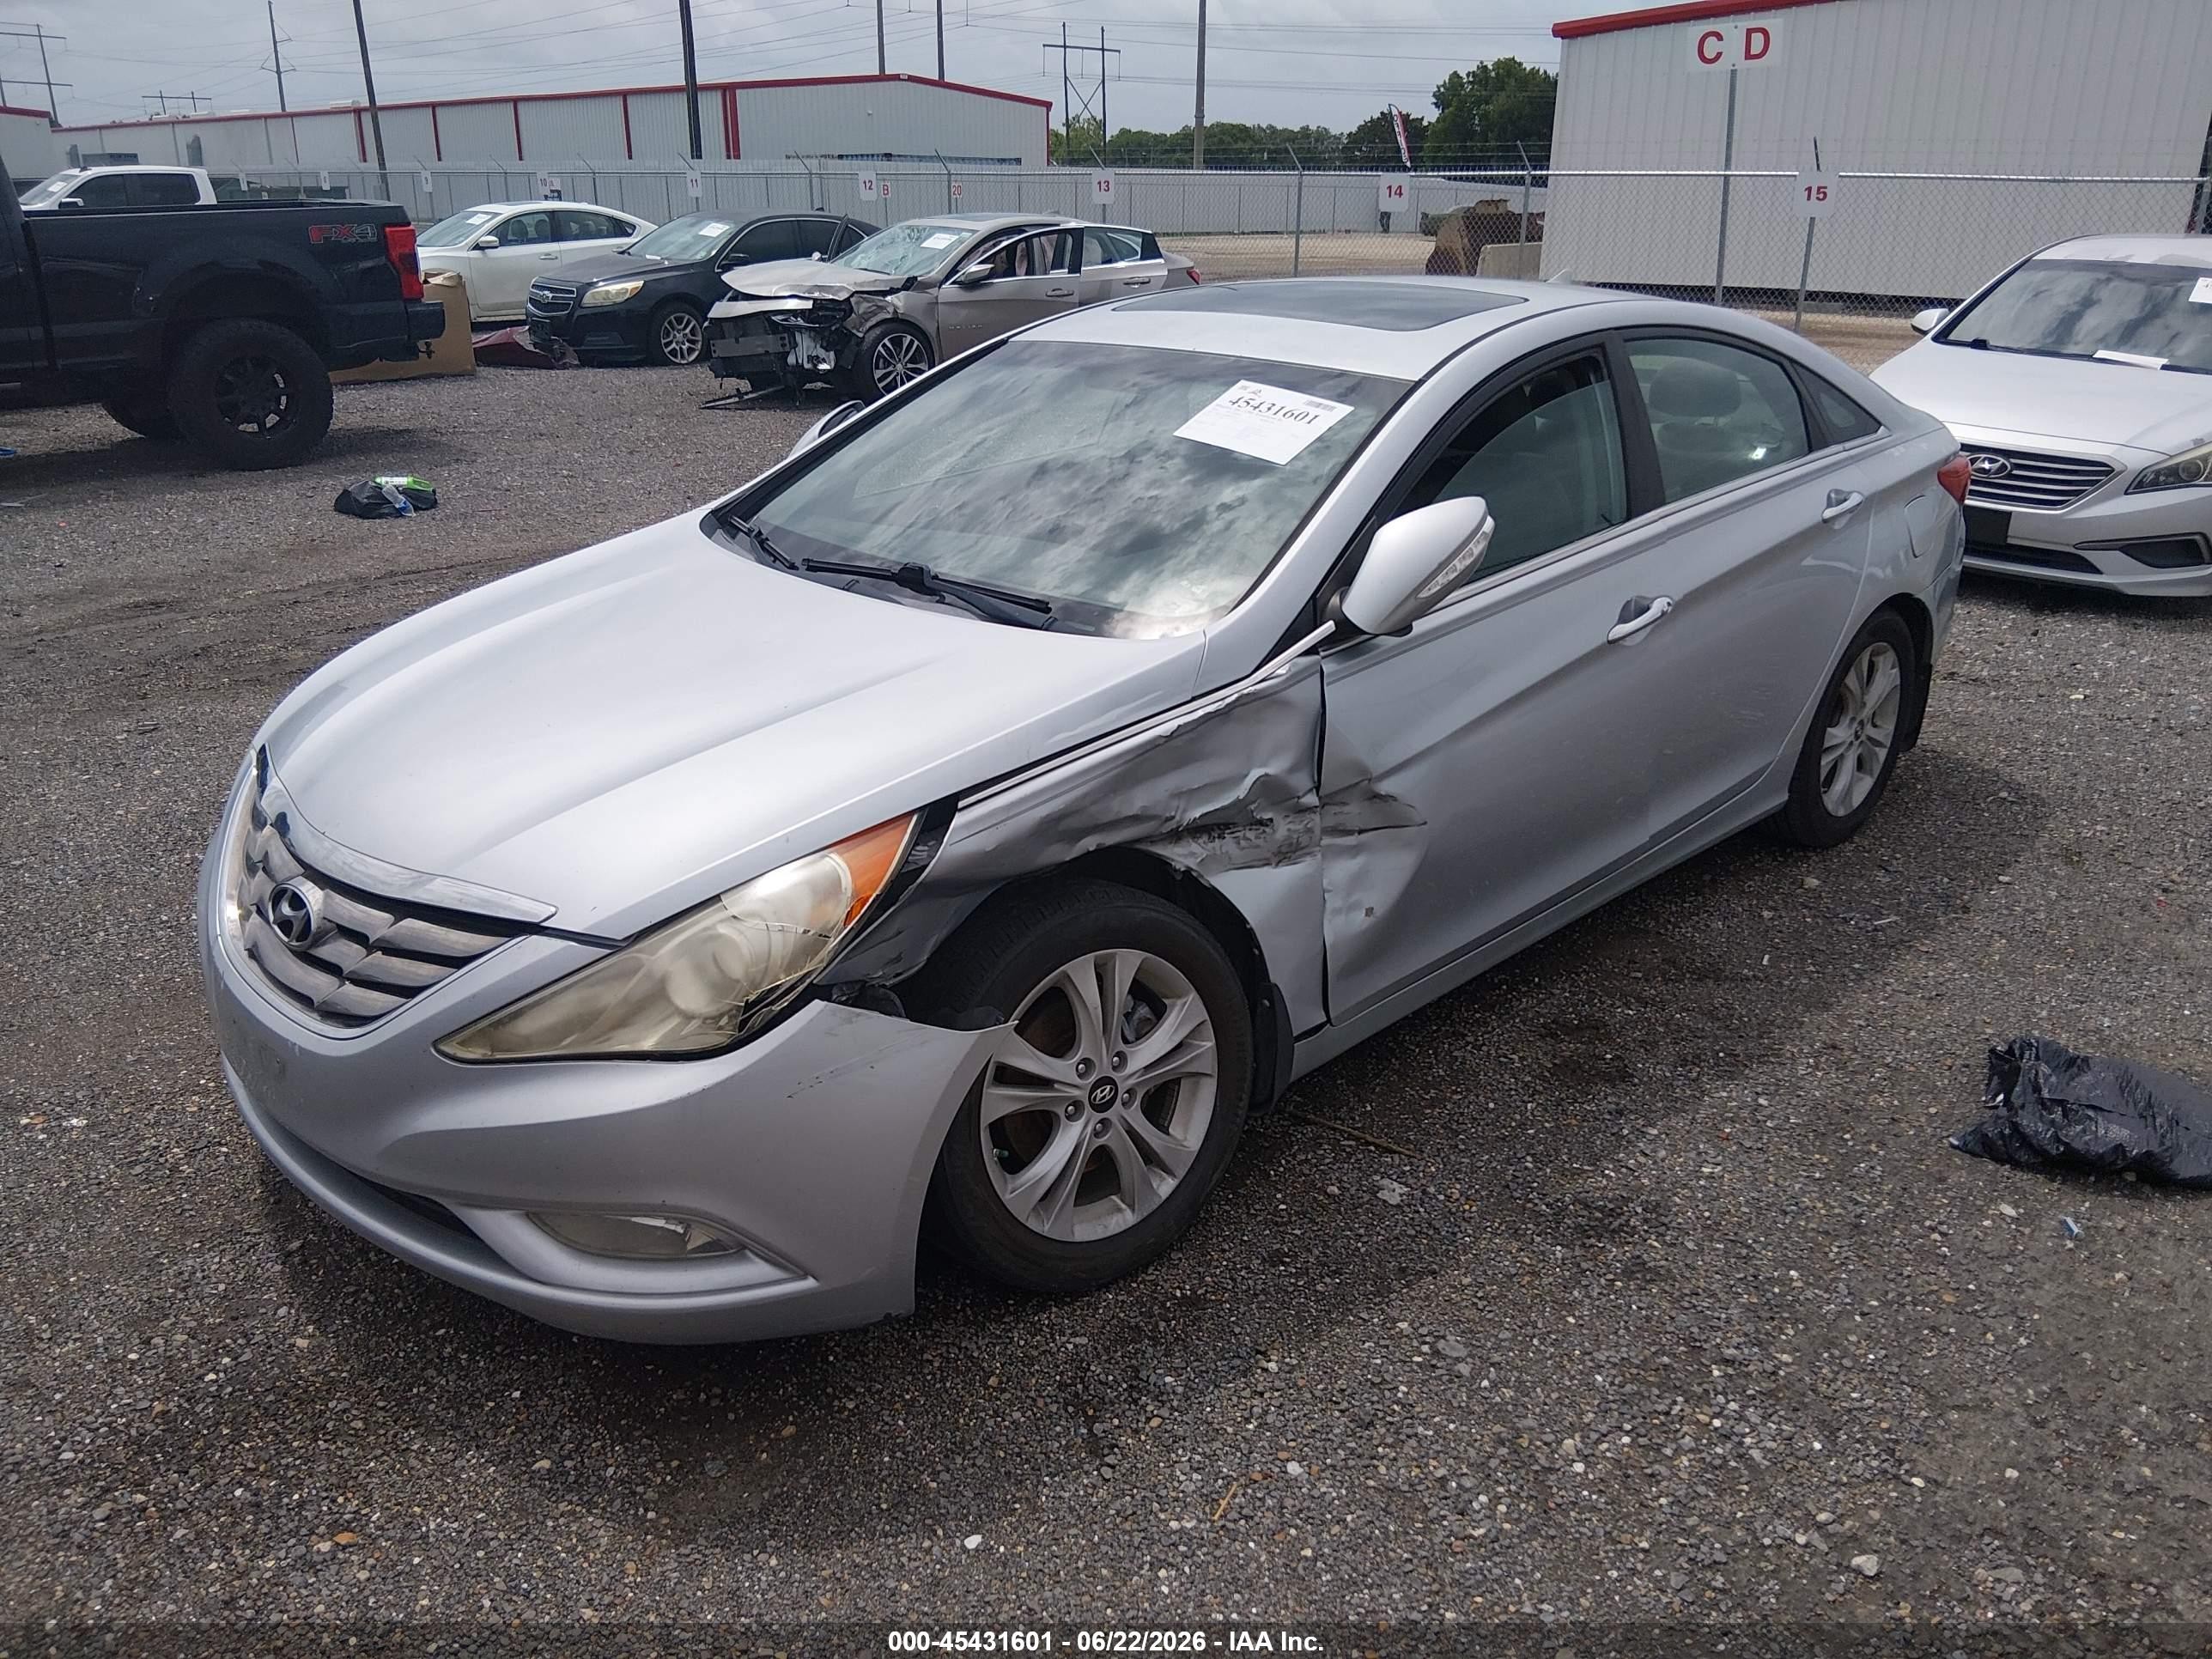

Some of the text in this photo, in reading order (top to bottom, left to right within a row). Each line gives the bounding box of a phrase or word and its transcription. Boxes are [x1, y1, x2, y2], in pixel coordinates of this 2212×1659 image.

[1697, 27, 1771, 64] C D
[539, 178, 548, 187] 10
[690, 179, 698, 188] 11
[863, 179, 873, 191] 12
[1097, 179, 1110, 192] 13
[882, 184, 890, 196] B
[952, 185, 962, 197] 20
[1386, 185, 1404, 198] 14
[1803, 185, 1828, 202] 15
[309, 224, 378, 244] FX4
[1228, 396, 1322, 425] 45431601
